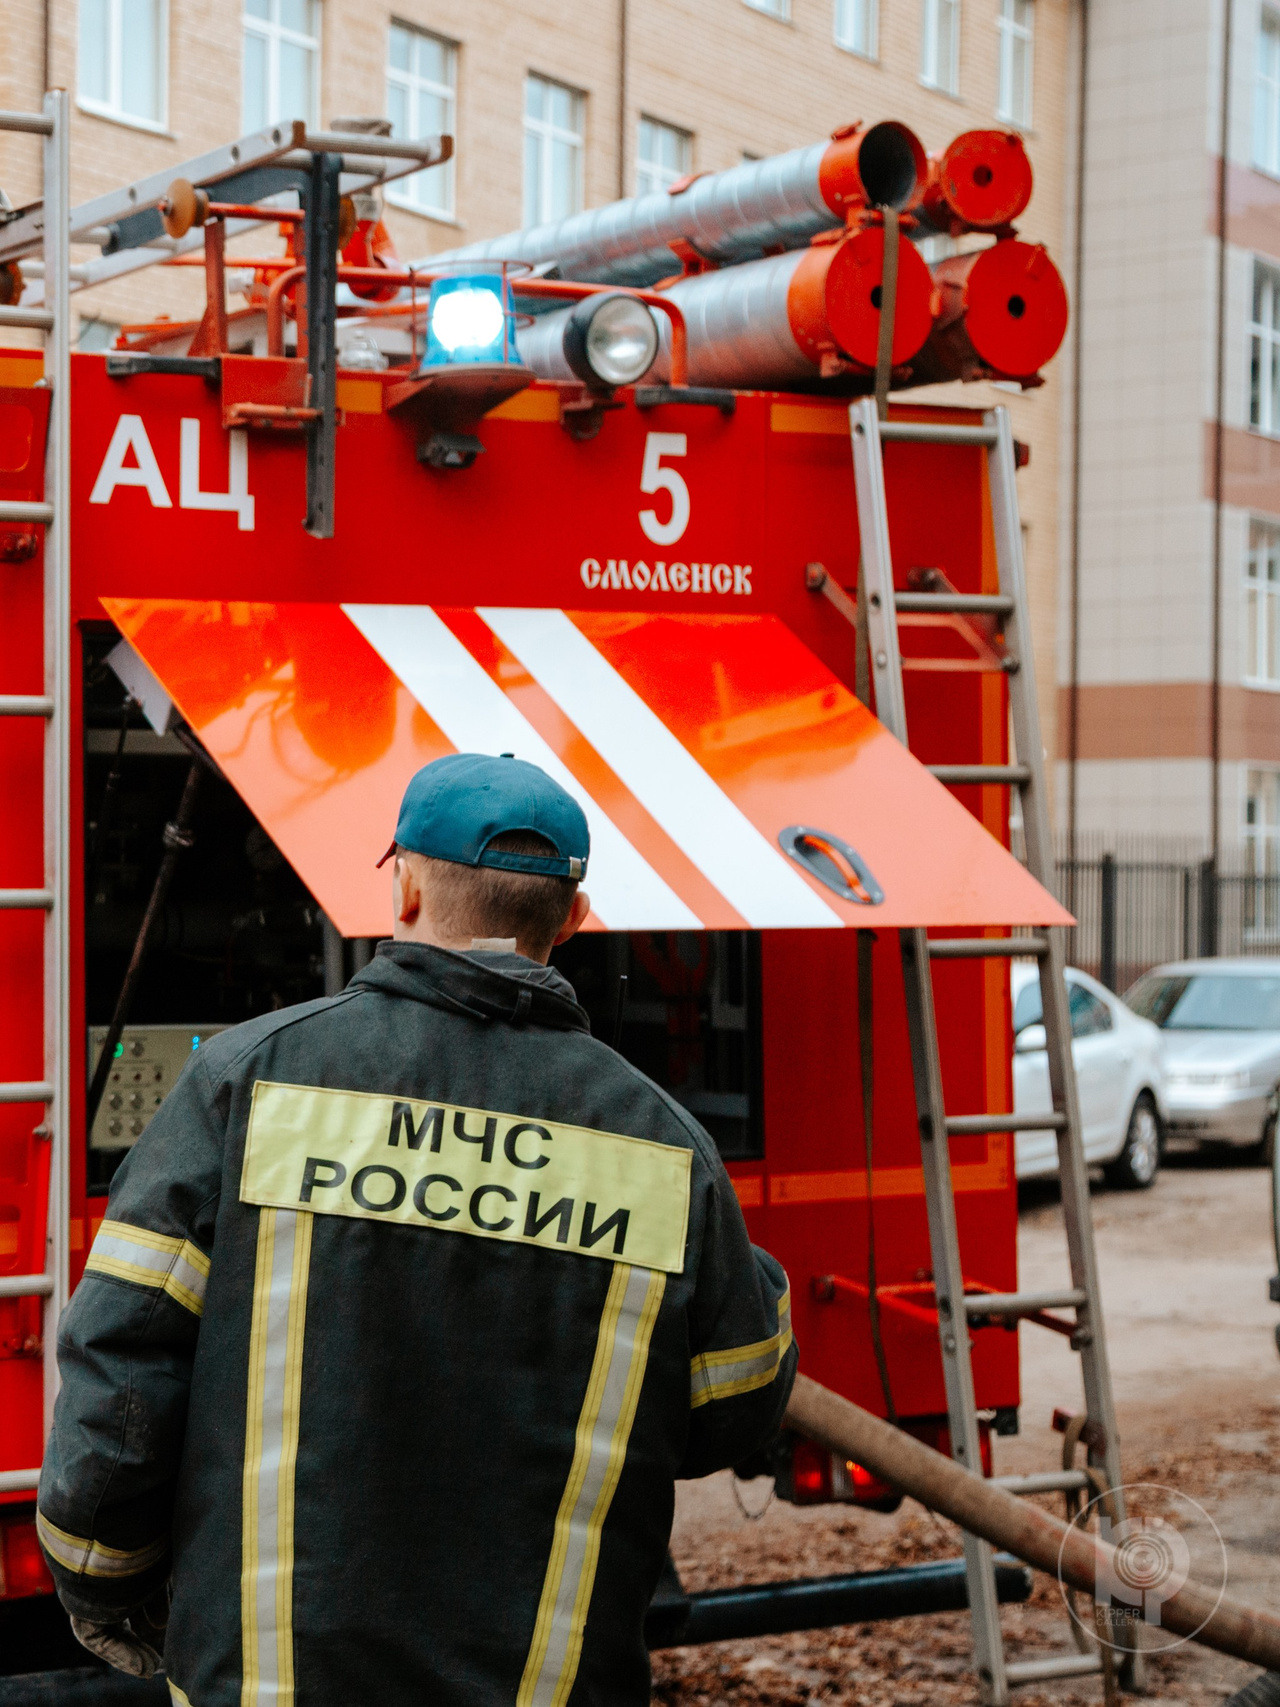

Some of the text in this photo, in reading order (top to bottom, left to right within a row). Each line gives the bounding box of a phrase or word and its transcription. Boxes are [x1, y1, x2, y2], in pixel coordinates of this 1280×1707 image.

[89, 414, 255, 532] АЦ
[638, 431, 691, 546] 5
[580, 557, 753, 595] СМОЛЕНСК
[387, 1101, 554, 1170] МЧС
[298, 1156, 631, 1256] РОССИИ
